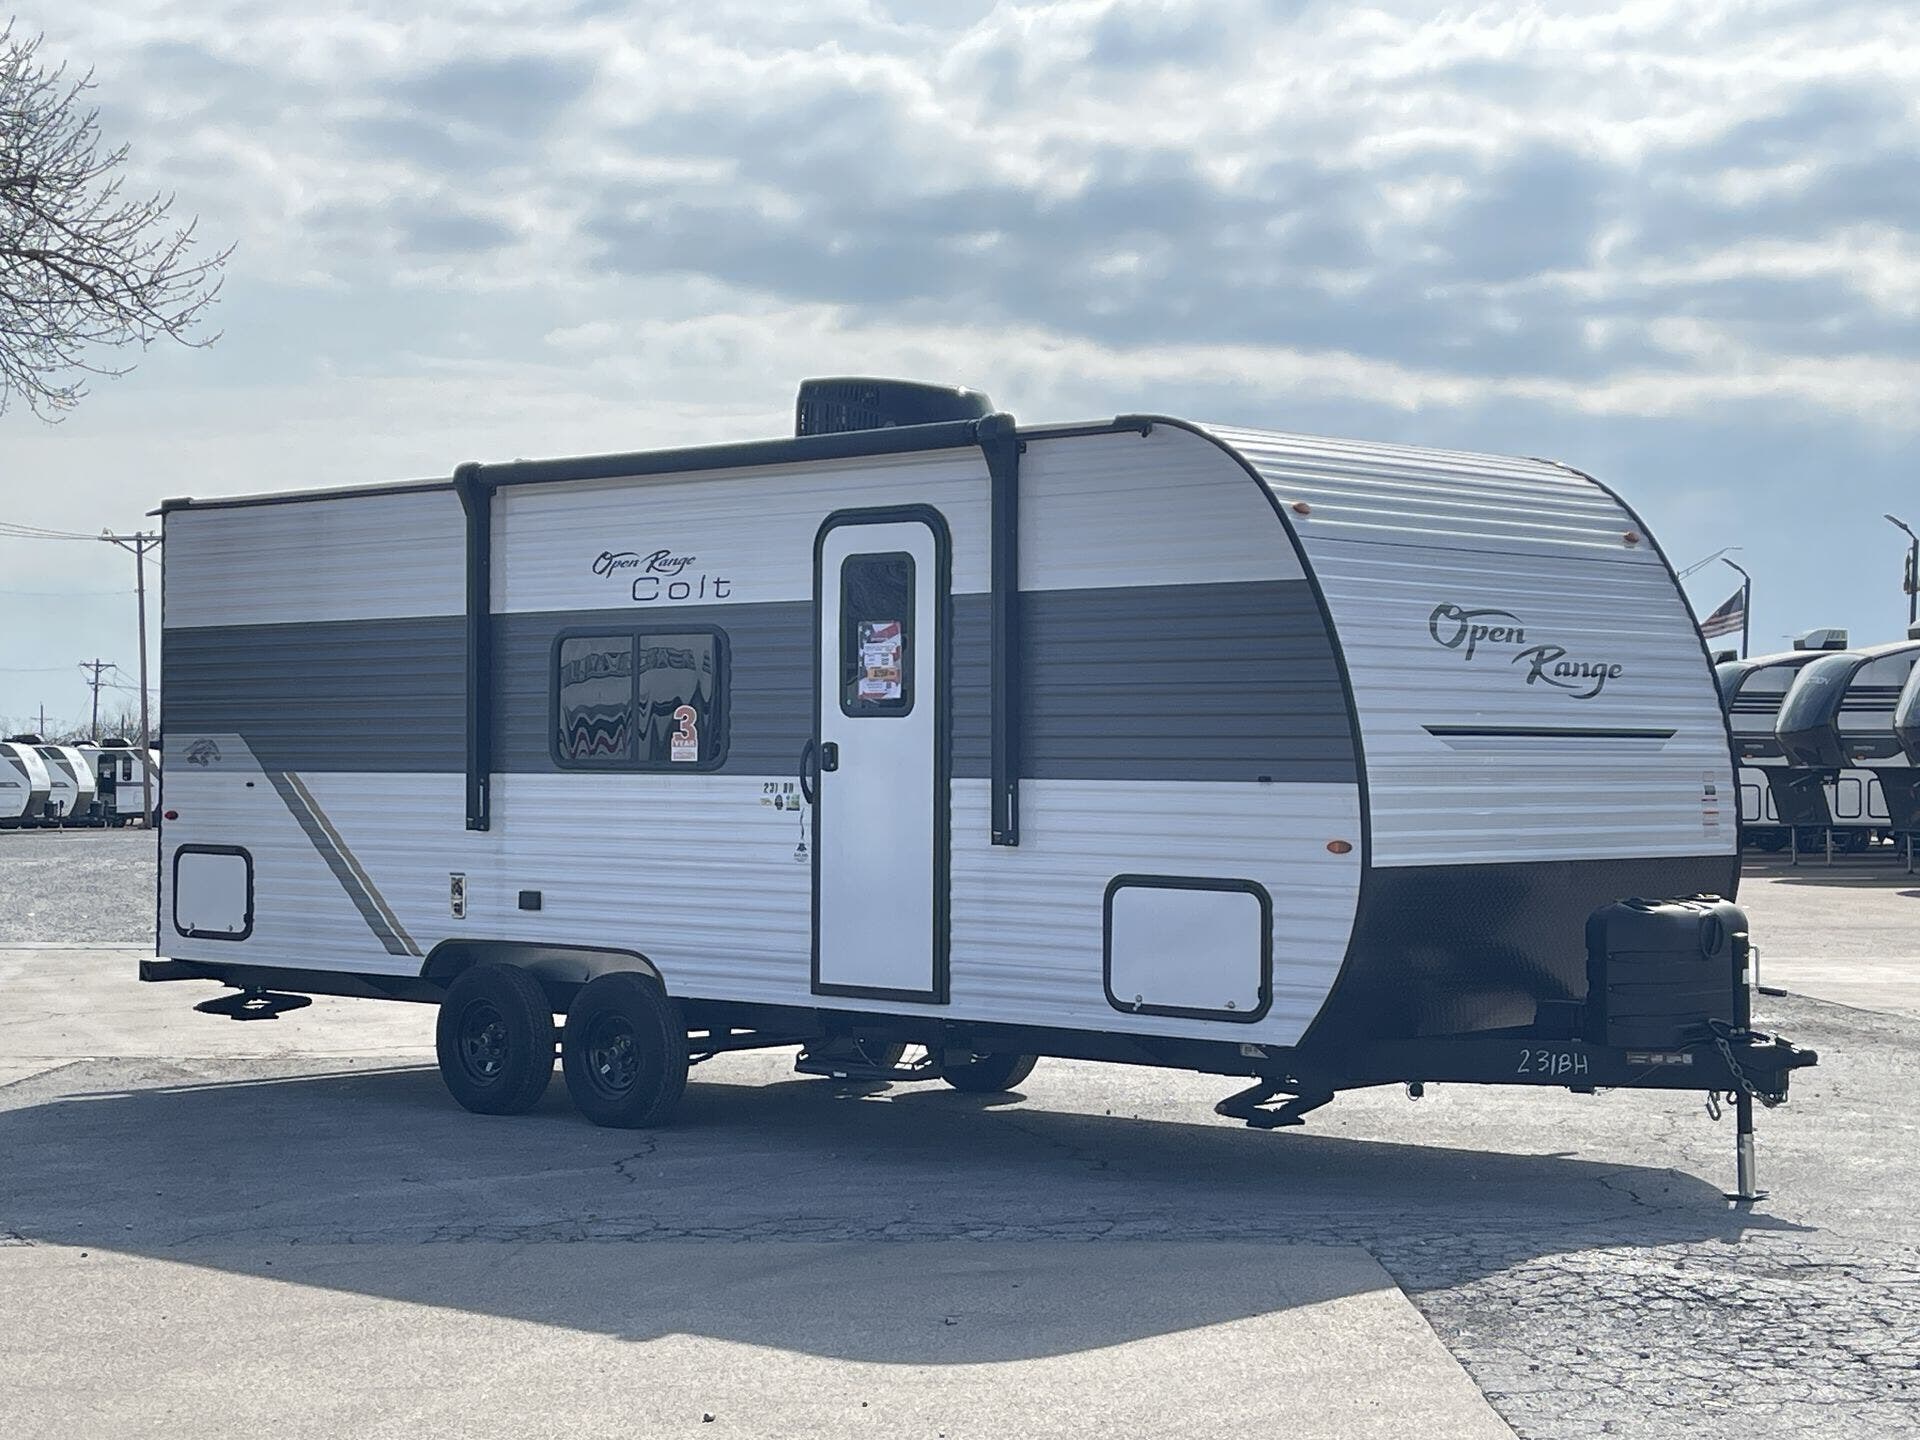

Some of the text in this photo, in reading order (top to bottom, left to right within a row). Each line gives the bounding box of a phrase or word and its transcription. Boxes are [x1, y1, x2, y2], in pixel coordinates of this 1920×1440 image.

[592, 549, 697, 579] Open Range
[632, 574, 731, 601] Colt
[1429, 603, 1526, 661] Open
[1511, 644, 1624, 700] Range
[673, 704, 698, 740] 3
[672, 739, 697, 748] YEAR
[1517, 1049, 1589, 1076] 231BH
